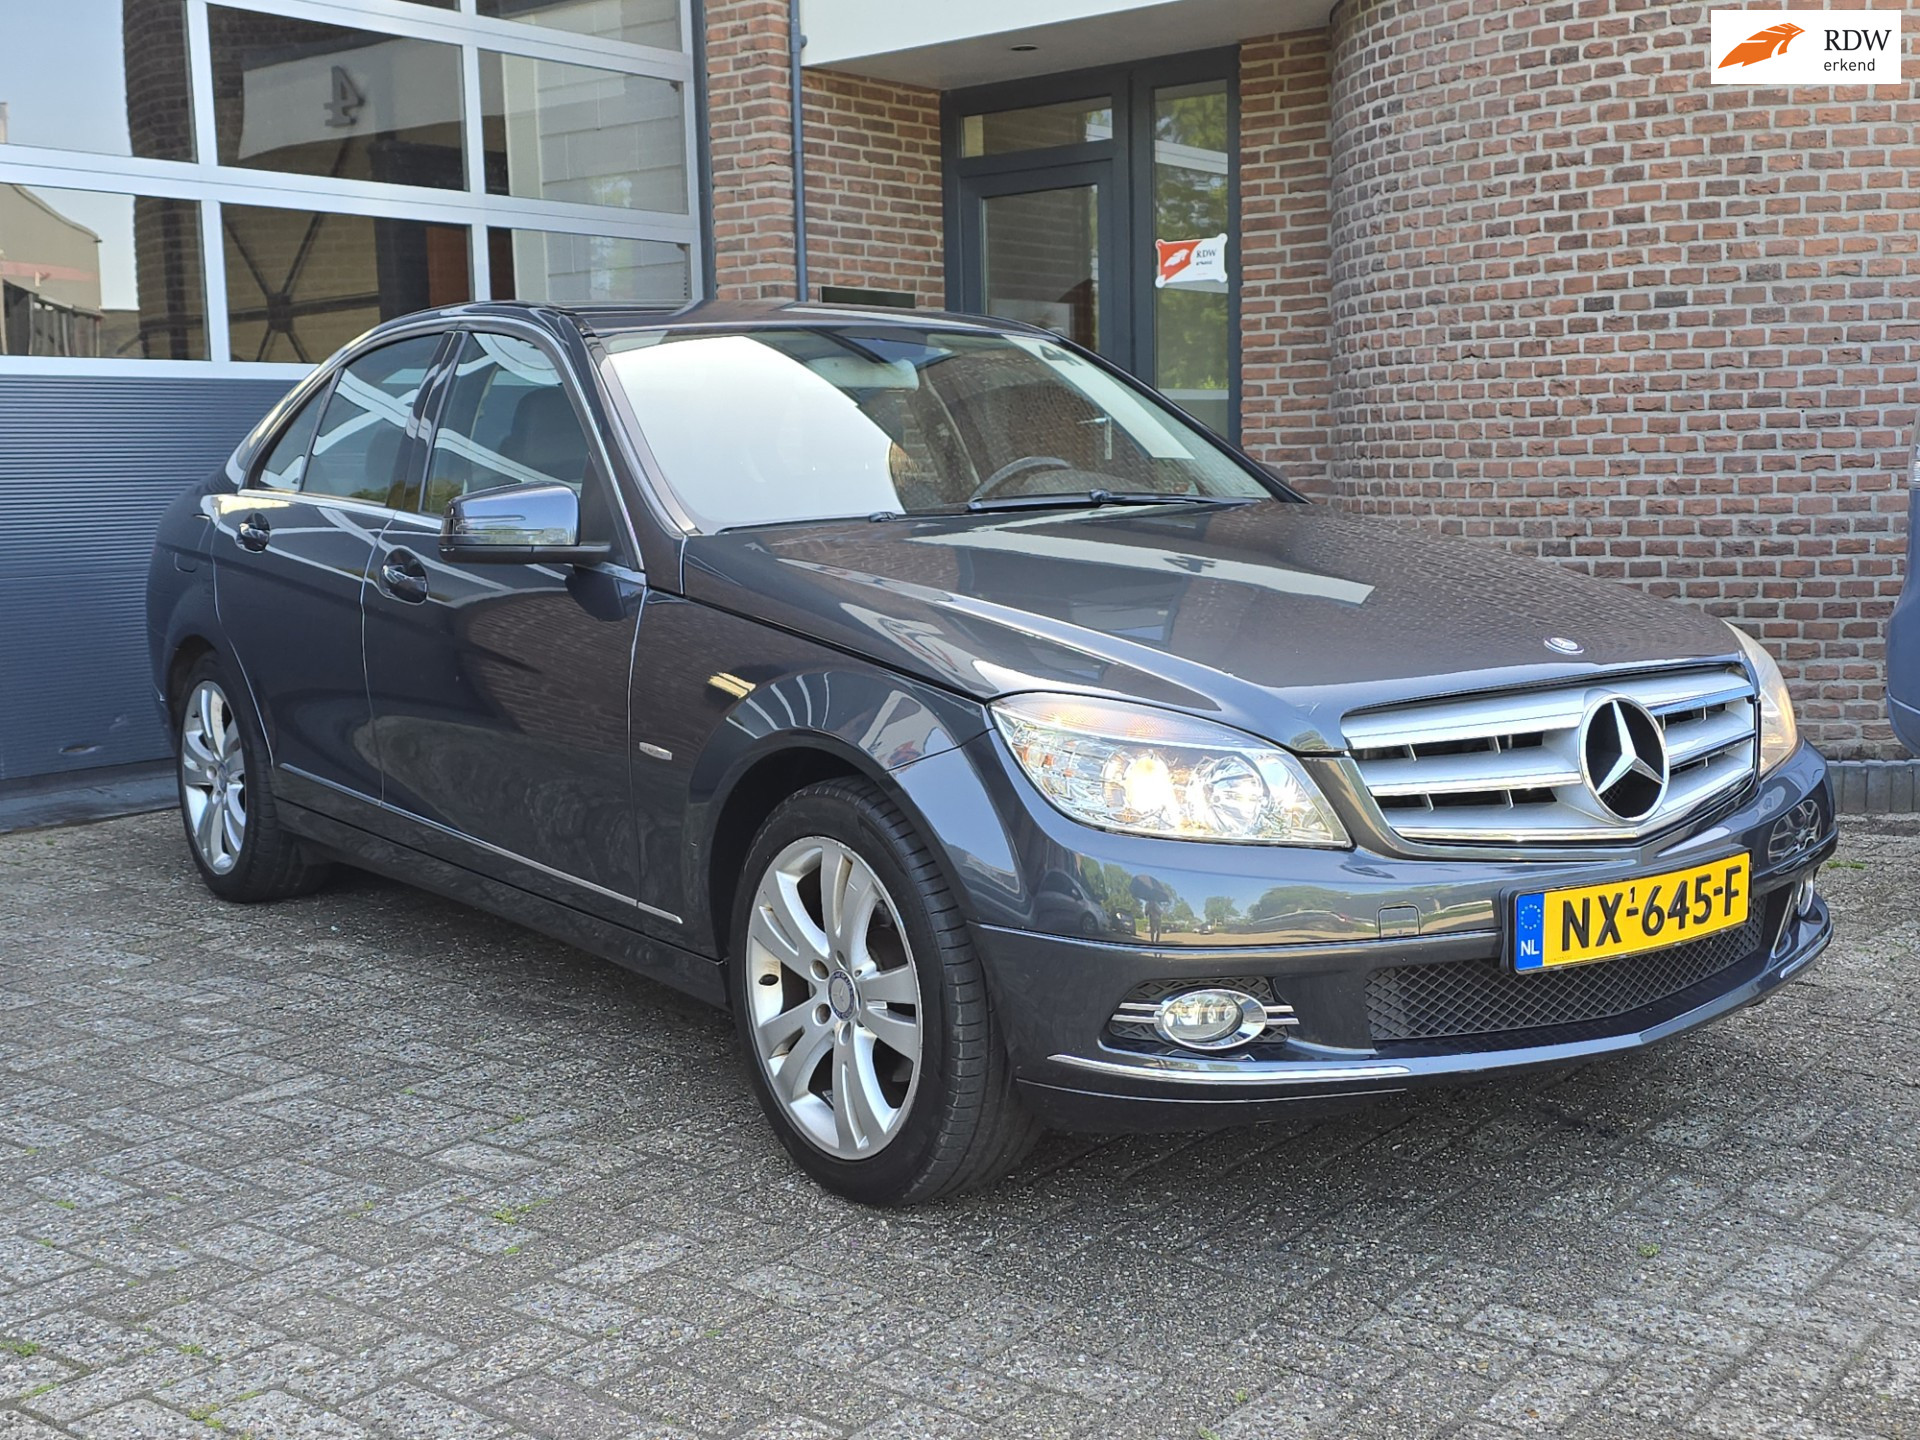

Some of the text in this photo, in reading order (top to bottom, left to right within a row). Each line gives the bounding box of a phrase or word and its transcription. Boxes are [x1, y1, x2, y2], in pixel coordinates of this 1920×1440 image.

[1196, 249, 1217, 258] RDW
[1561, 865, 1742, 952] NX-645-F
[1520, 939, 1540, 957] NL
